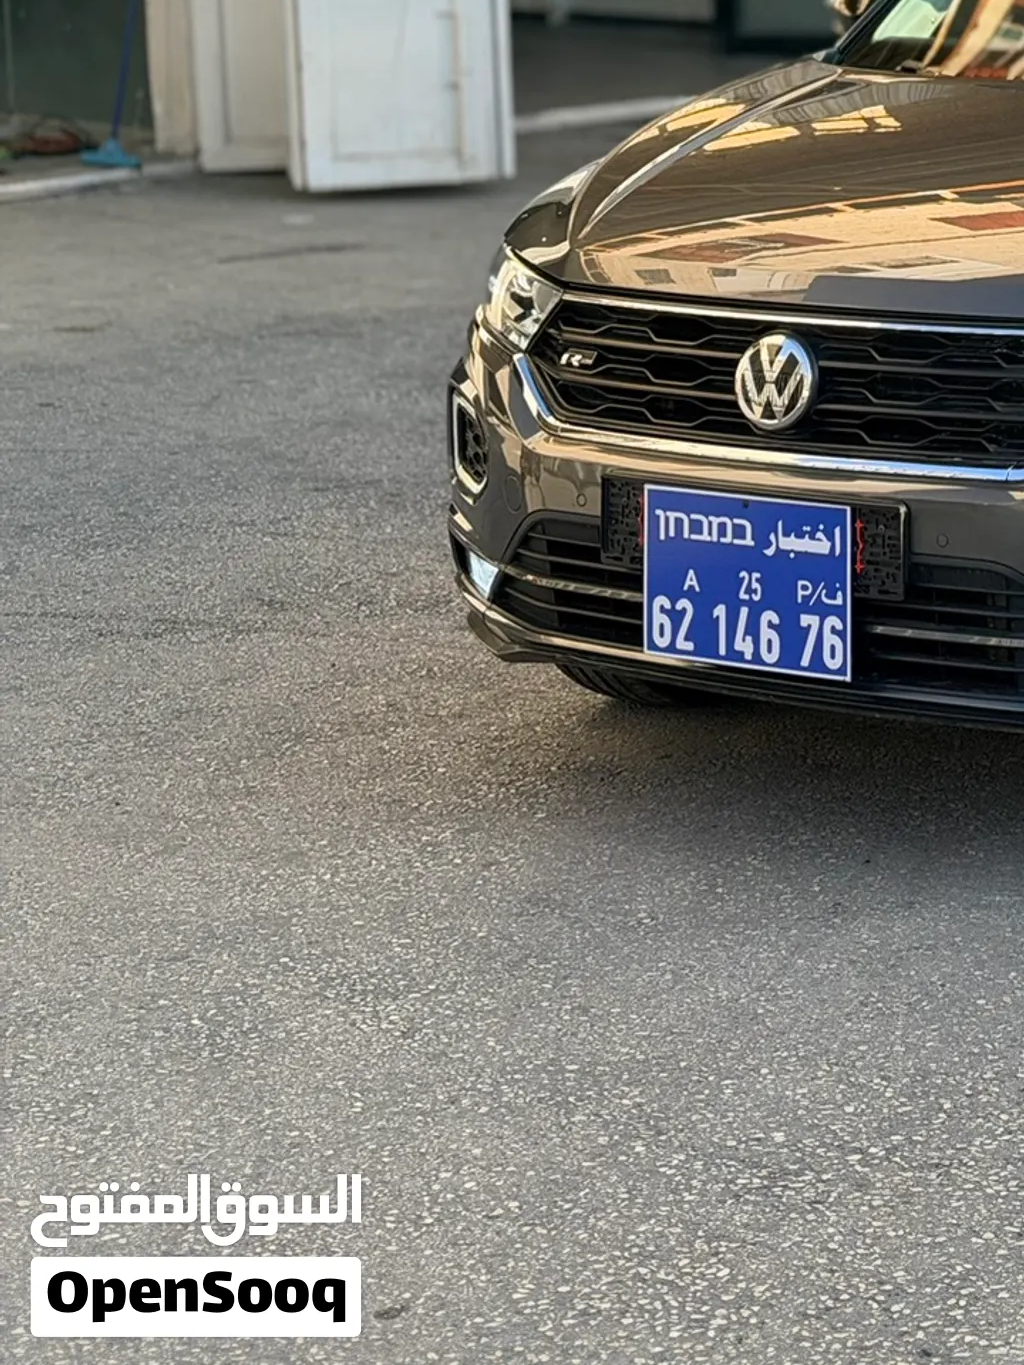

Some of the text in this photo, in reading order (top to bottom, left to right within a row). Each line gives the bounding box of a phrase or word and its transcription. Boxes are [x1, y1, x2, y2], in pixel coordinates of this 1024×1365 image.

[737, 333, 812, 430] VW
[655, 508, 755, 547] במבחן
[763, 520, 840, 558] اختبار
[683, 569, 700, 592] A
[738, 571, 762, 601] 25
[652, 595, 844, 670] 62 146 76
